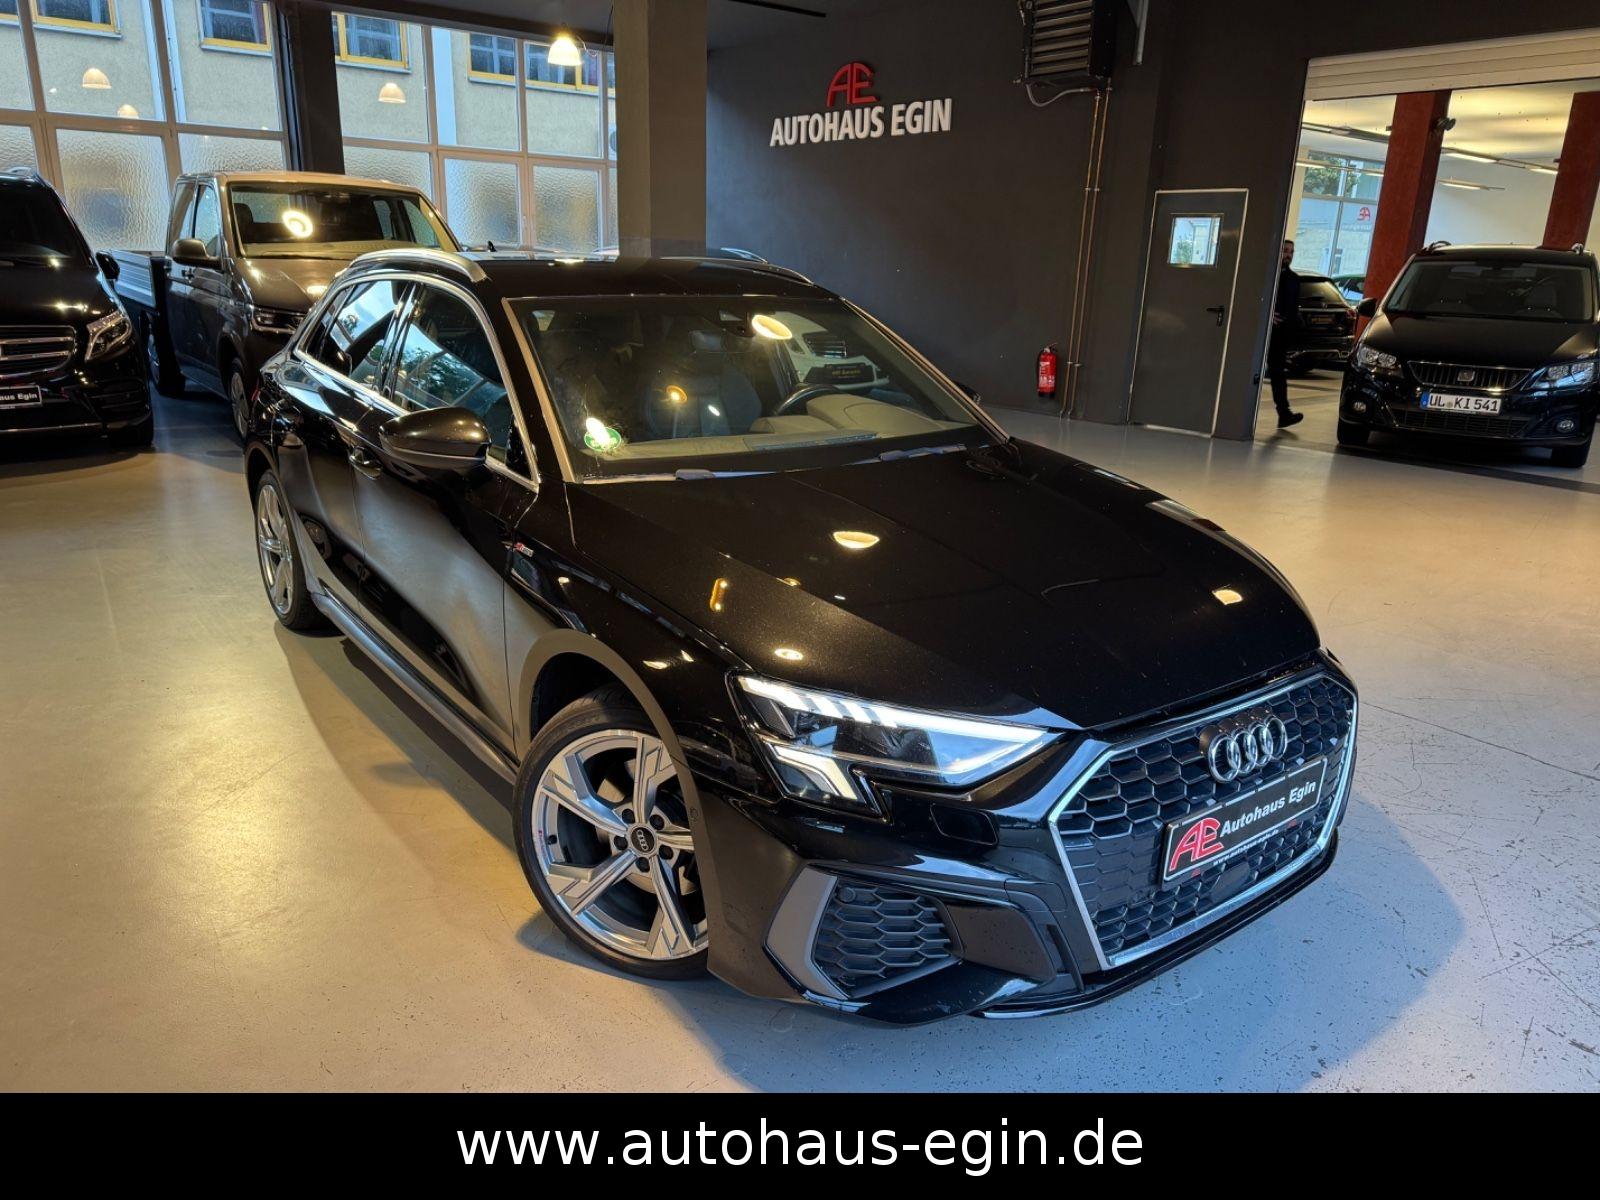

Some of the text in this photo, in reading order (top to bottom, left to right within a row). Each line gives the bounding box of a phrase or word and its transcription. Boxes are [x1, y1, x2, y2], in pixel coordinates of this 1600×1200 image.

[769, 98, 952, 147] AUTOHAUS EGIN
[1429, 394, 1498, 412] UL KI 541
[1219, 796, 1286, 838] Autohaus
[1288, 781, 1317, 803] Egin
